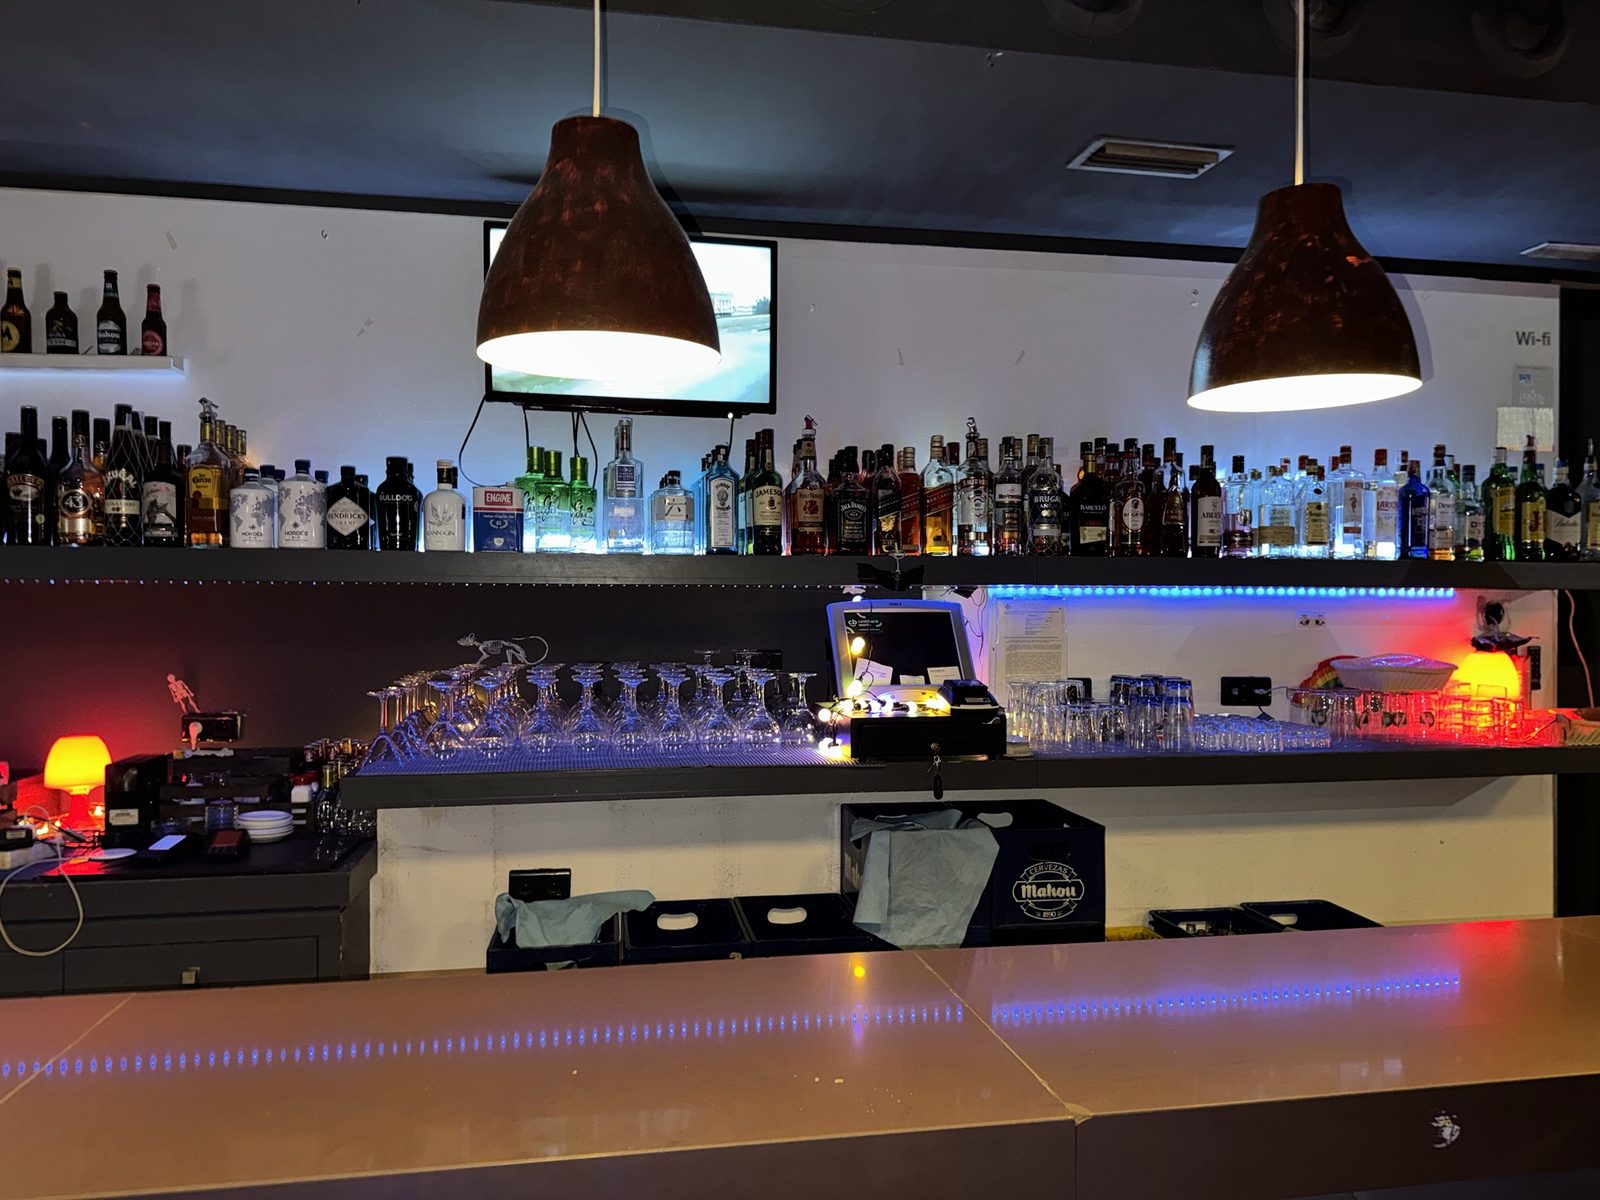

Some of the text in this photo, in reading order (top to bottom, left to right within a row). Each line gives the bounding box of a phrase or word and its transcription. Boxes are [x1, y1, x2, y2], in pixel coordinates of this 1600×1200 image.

[1515, 331, 1551, 347] Wi-fi
[64, 495, 84, 509] 43
[379, 491, 413, 502] BULLDOG
[486, 493, 512, 503] ENGINE
[1029, 863, 1069, 876] CERVEZAS
[1021, 882, 1077, 899] Mahou
